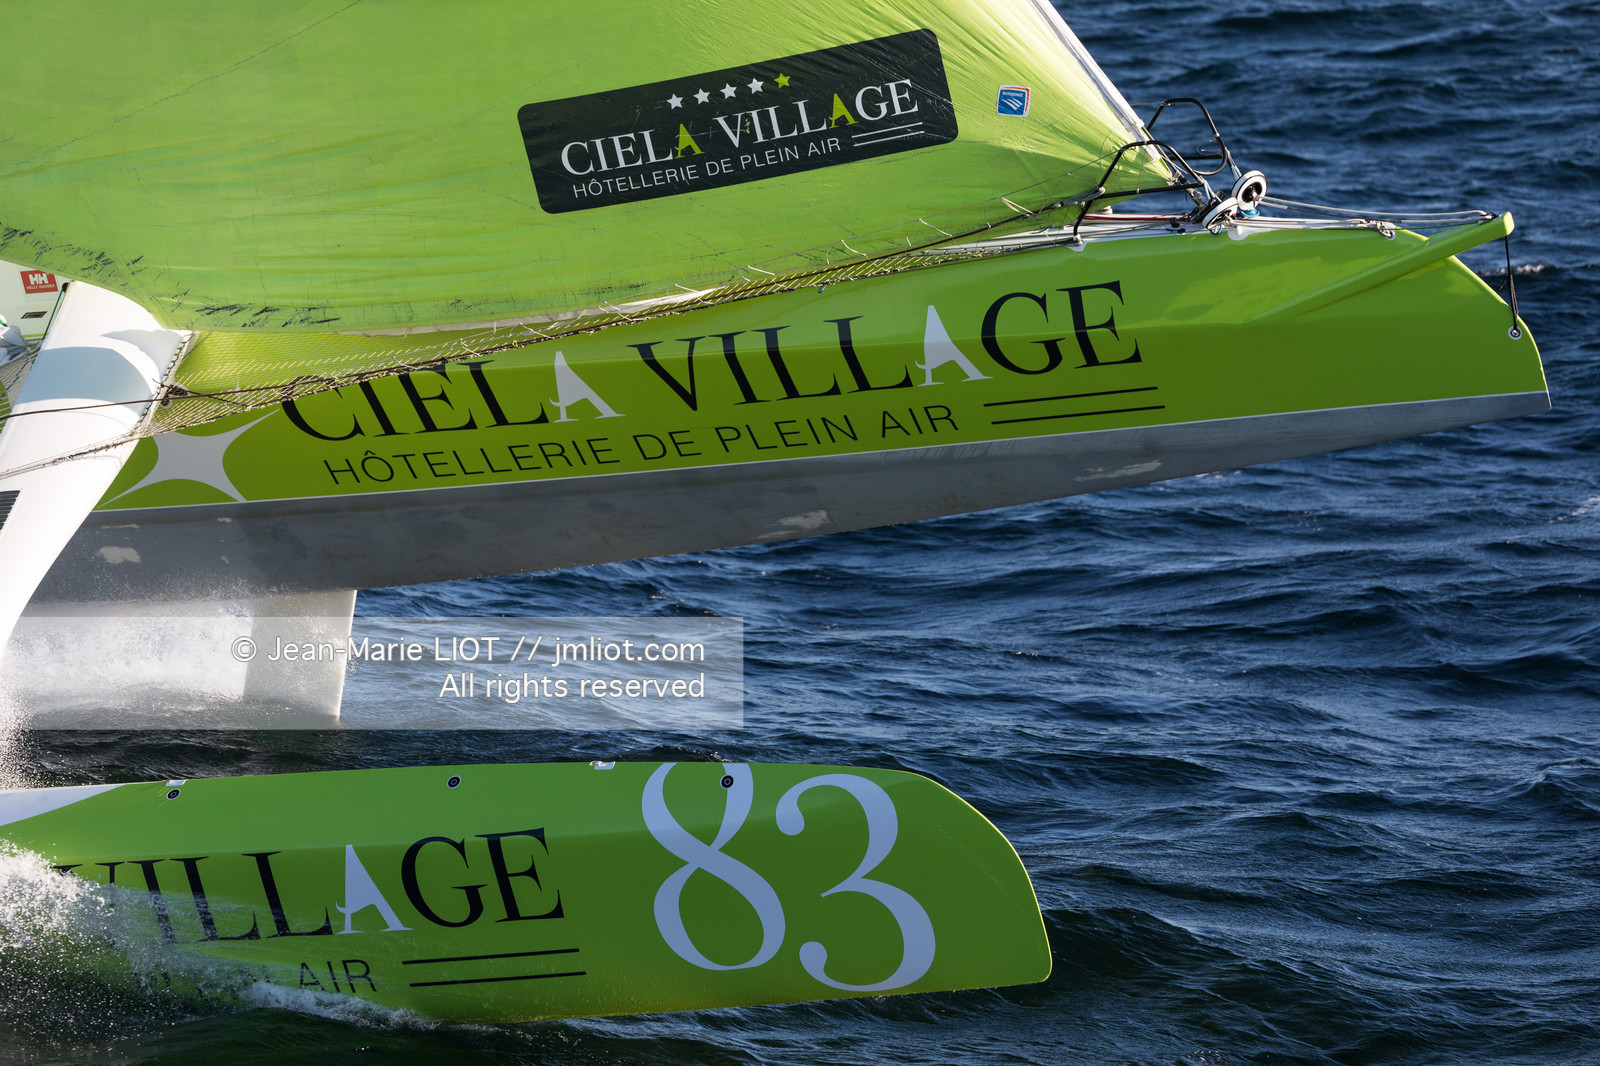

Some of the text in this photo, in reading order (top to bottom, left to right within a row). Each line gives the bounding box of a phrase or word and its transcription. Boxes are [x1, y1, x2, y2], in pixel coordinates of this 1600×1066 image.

[713, 78, 919, 149] VILLAGE
[572, 136, 842, 199] HÔTELLERIE DE PLEIN AIR
[28, 272, 49, 285] HH
[626, 280, 1143, 412] VILLAGE
[323, 404, 959, 485] HÔTELLERIE DE PLEIN AIR
[641, 762, 936, 992] 83
[300, 959, 377, 993] AIR
